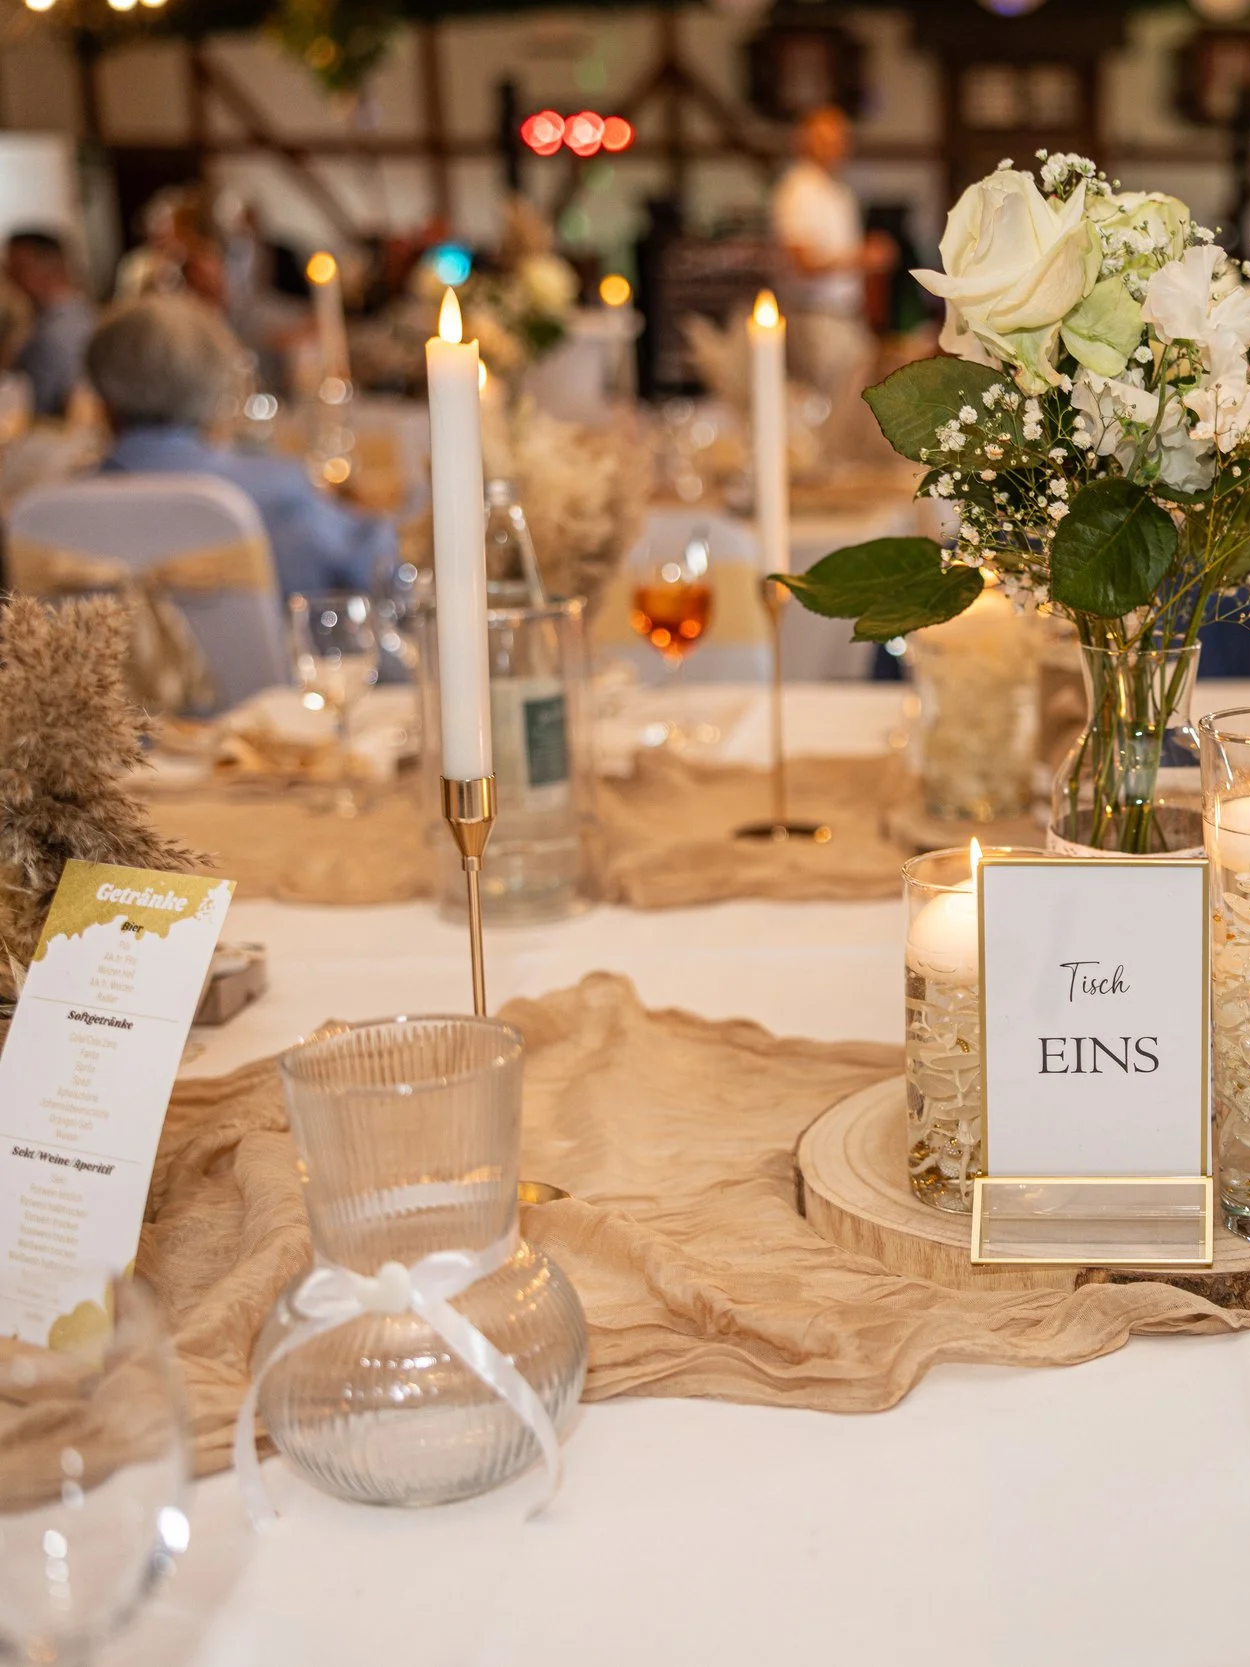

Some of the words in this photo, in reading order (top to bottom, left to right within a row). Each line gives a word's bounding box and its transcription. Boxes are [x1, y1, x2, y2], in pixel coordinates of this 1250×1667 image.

[96, 882, 189, 912] Getränke
[120, 921, 145, 933] Bier
[1059, 962, 1130, 1002] Tisch
[67, 1009, 134, 1030] Softgetränke
[1038, 1037, 1159, 1074] EINS
